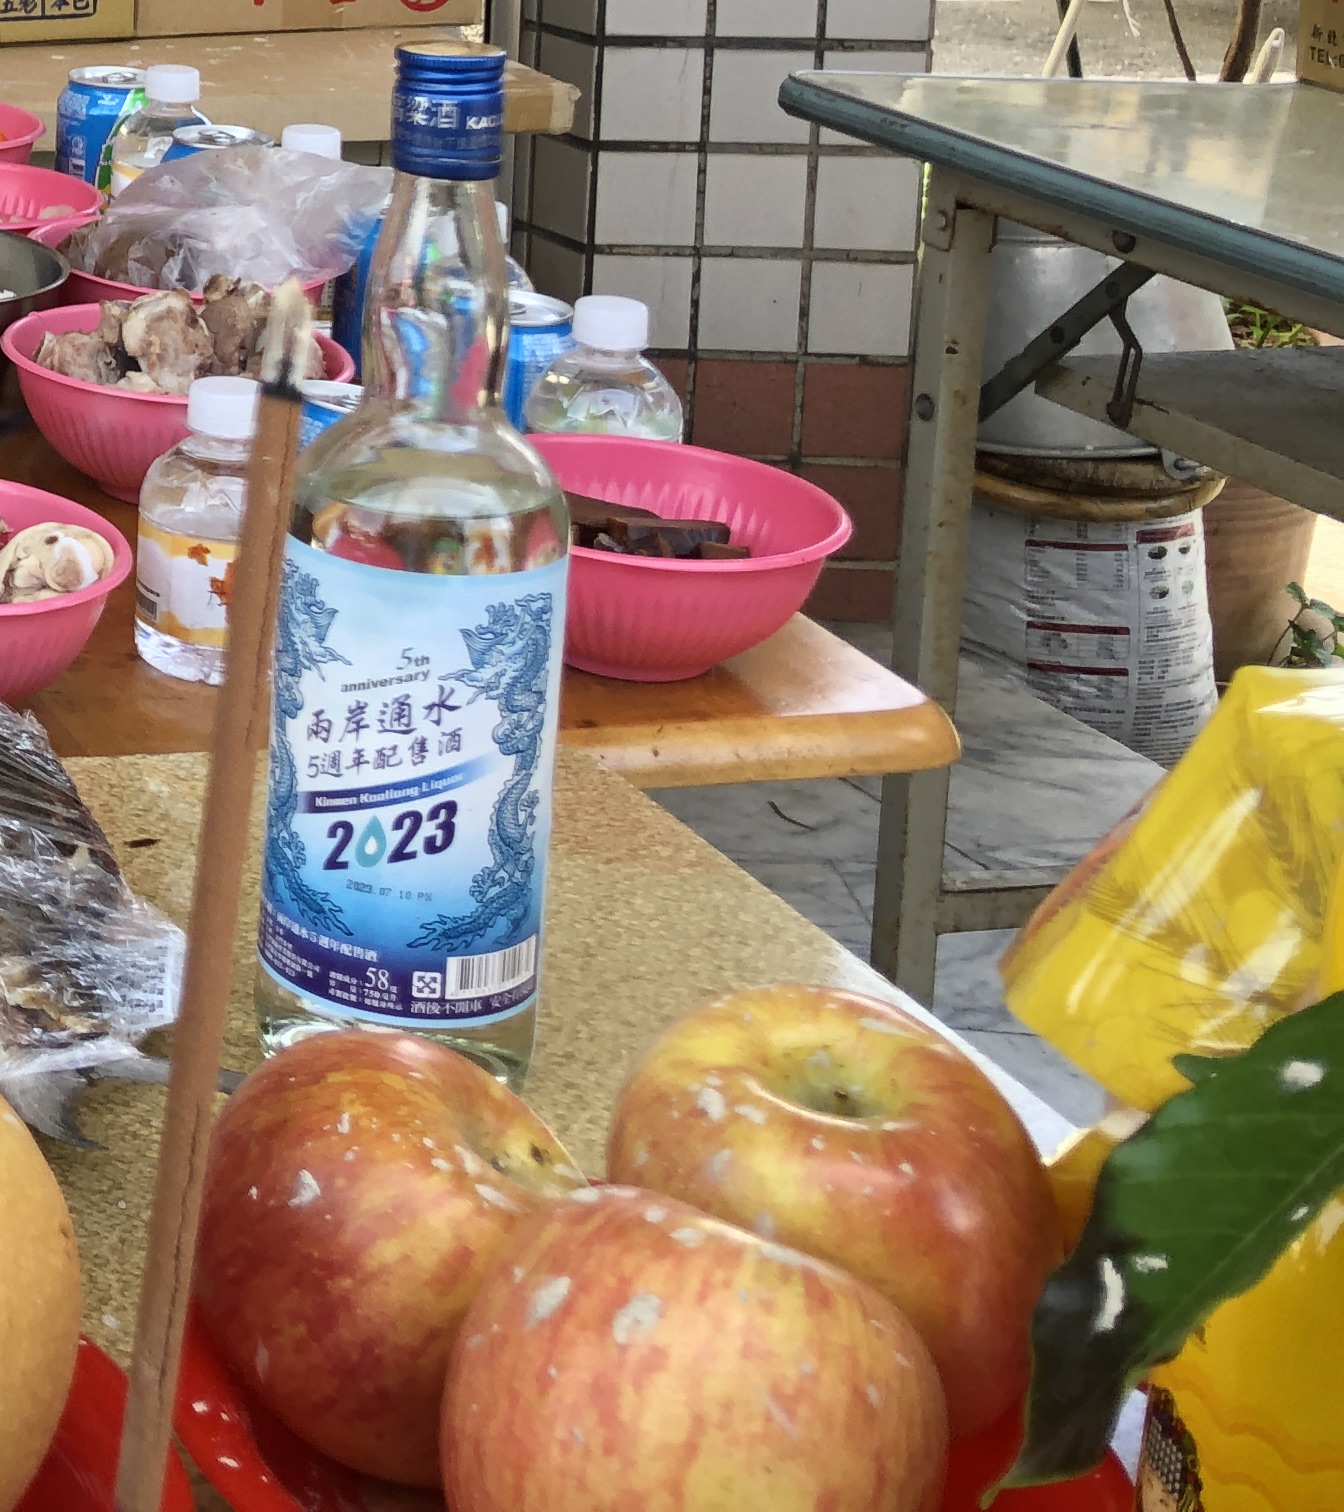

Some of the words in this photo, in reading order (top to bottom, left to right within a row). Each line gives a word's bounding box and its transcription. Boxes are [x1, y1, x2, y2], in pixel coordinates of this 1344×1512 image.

[396, 646, 431, 671] 5th
[339, 668, 431, 694] anniversary
[305, 684, 464, 745] 兩岸通水
[305, 726, 464, 779] 5週年配售酒
